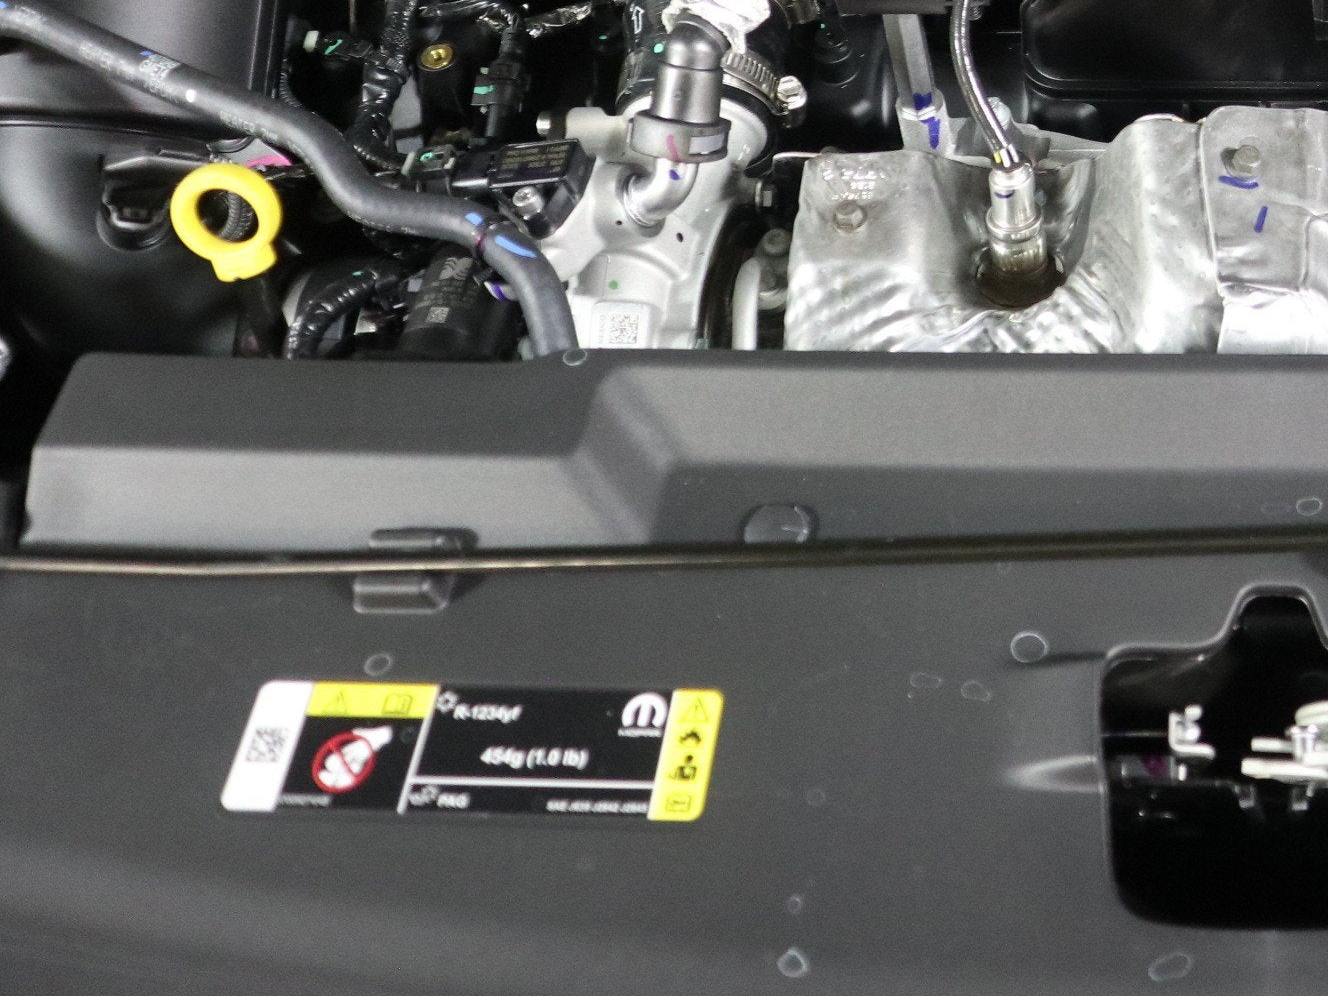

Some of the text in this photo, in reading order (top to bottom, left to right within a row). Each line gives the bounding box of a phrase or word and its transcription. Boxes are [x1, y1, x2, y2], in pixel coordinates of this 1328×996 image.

[452, 704, 523, 723] R-1234yf
[479, 746, 523, 770] 454g
[562, 748, 590, 771] lb)
